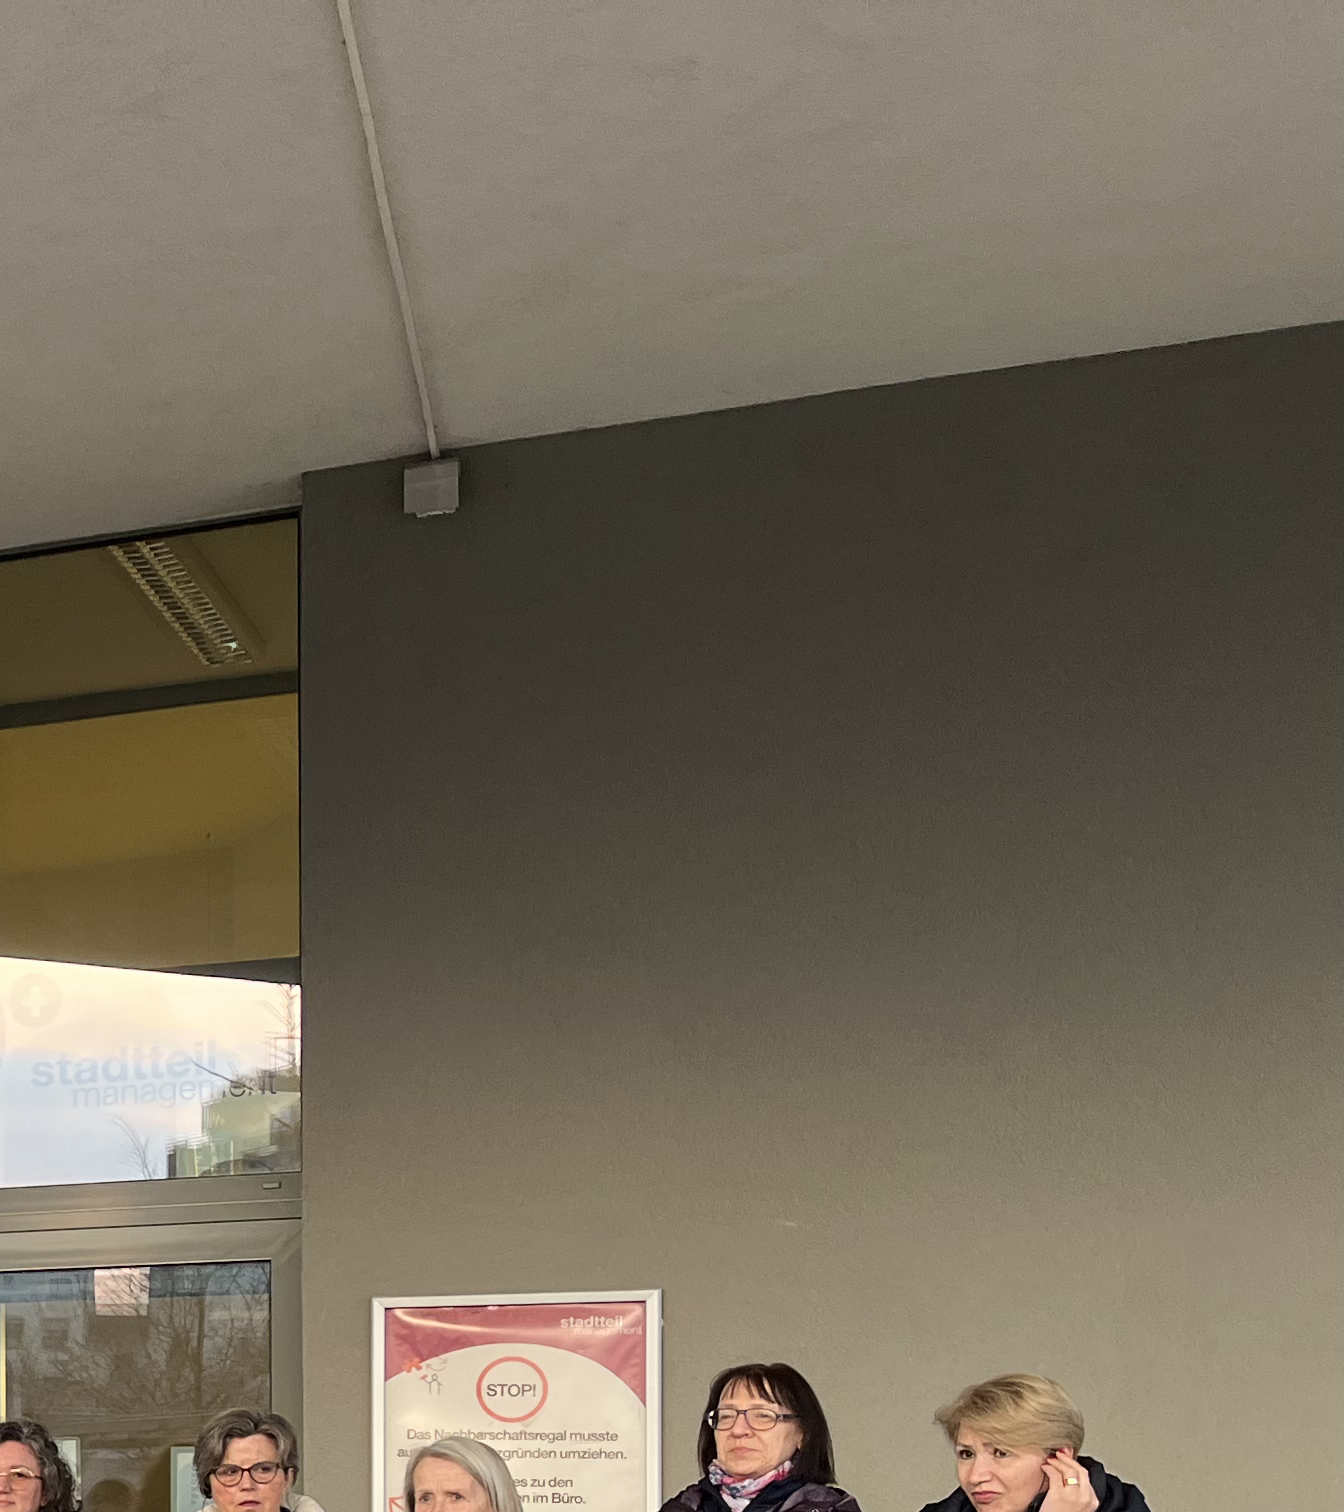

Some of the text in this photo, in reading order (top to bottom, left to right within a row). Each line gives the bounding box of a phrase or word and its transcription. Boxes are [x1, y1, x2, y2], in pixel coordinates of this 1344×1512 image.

[30, 1040, 217, 1088] stadtteil
[560, 1315, 624, 1329] stadtteil
[486, 1383, 537, 1398] STOP!
[406, 1429, 432, 1440] Das
[569, 1430, 619, 1442] musste
[559, 1448, 628, 1460] umziehen.
[530, 1478, 546, 1488] zu
[548, 1476, 574, 1488] den
[532, 1492, 549, 1504] im
[551, 1492, 587, 1504] Büro.
